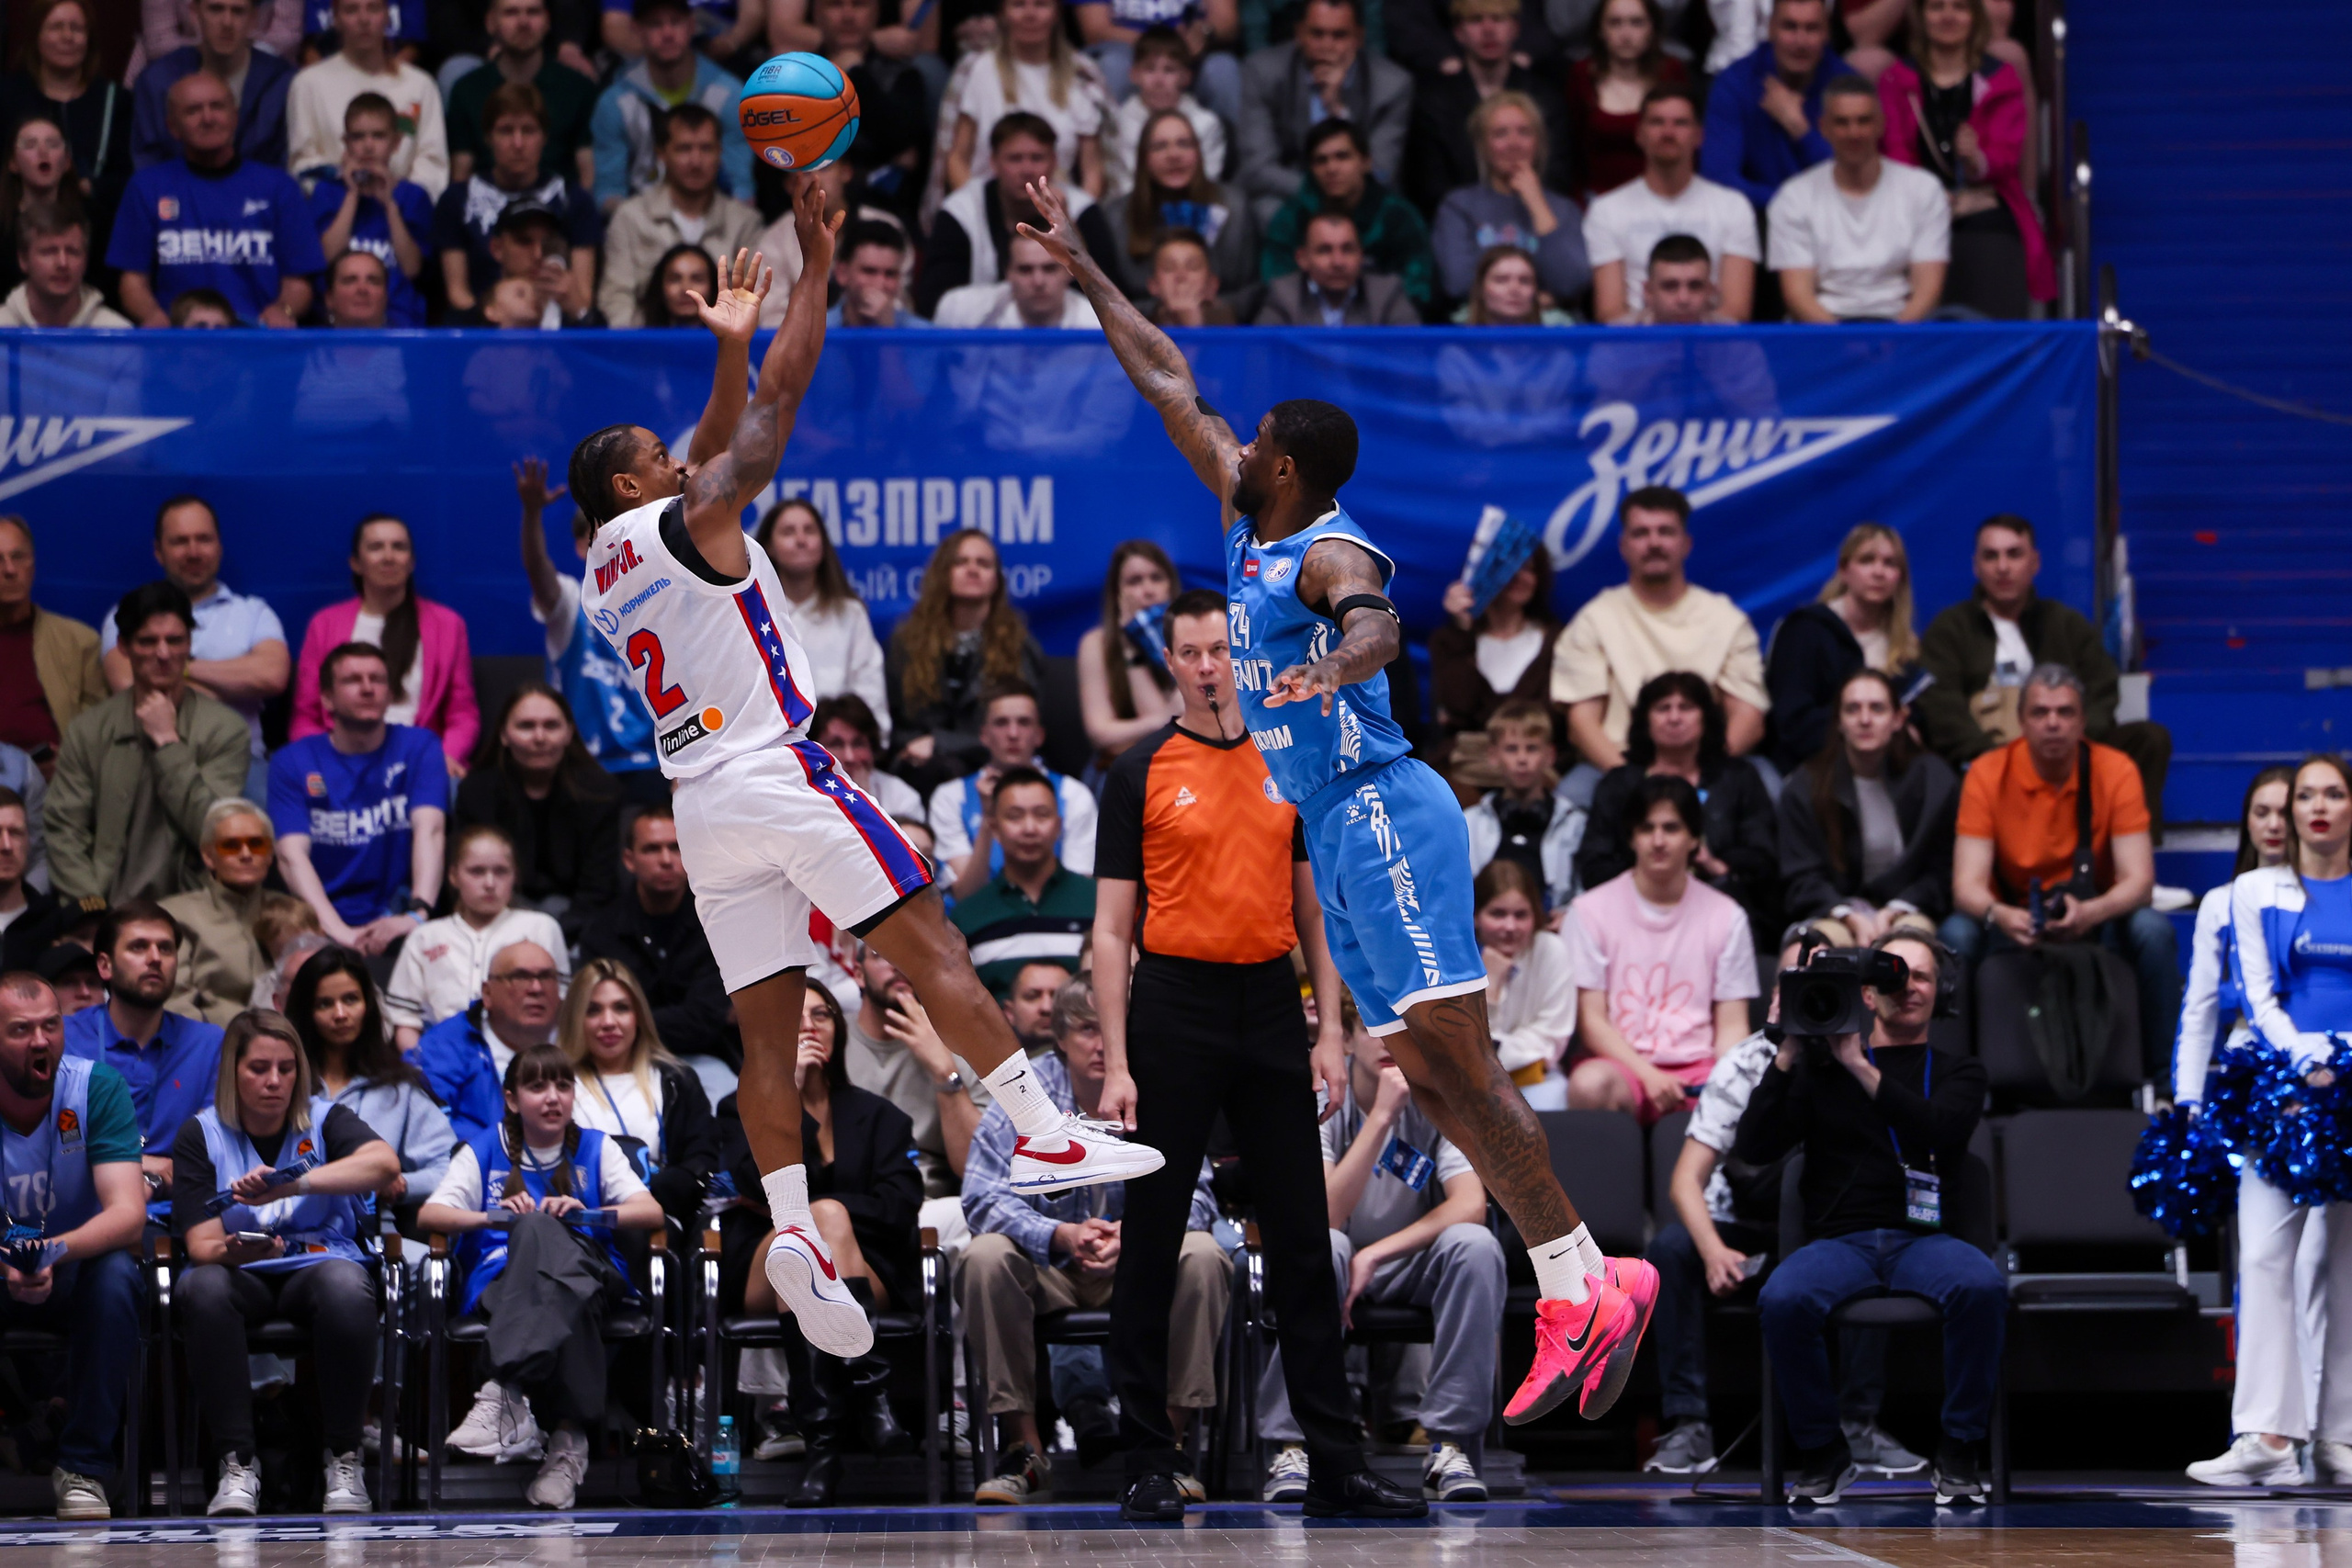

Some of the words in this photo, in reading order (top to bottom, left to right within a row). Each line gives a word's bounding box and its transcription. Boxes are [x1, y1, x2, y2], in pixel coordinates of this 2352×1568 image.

[760, 65, 782, 76] FIBA
[157, 228, 274, 258] ЗЕНИТ
[1543, 401, 1898, 571] Зенит
[620, 539, 644, 575] JR.
[618, 578, 672, 617] НОРНИКЕЛЬ
[1229, 602, 1250, 650] 24
[627, 627, 689, 720] 2
[1230, 659, 1273, 692] ENIT
[1175, 795, 1197, 807] PEAK
[1345, 814, 1368, 826] KELME
[1019, 1085, 1027, 1094] 2
[8, 1170, 57, 1218] 78
